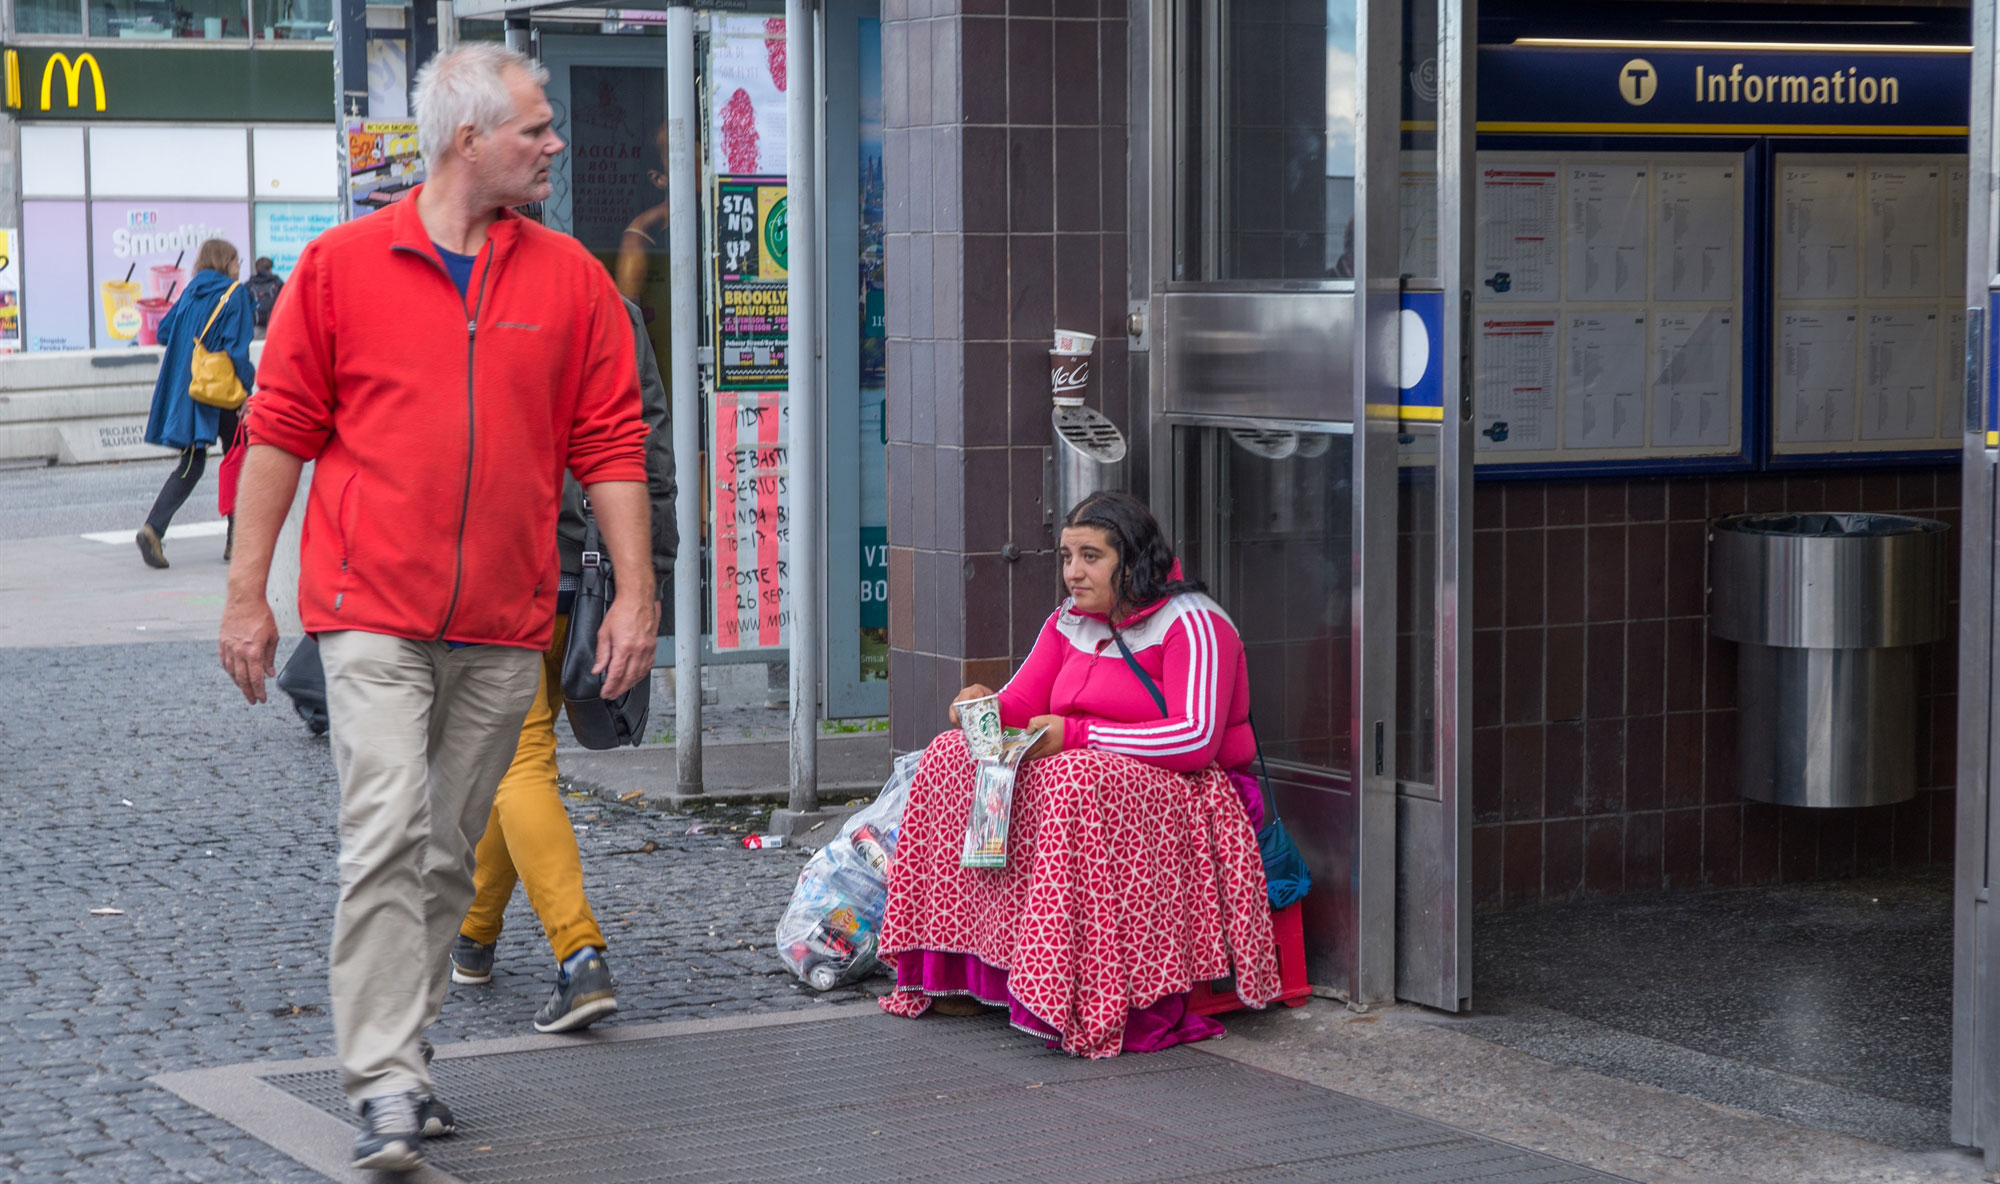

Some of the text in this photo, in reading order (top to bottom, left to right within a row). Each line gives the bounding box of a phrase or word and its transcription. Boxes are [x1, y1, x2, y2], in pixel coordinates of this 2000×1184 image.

[1696, 63, 1899, 105] Information
[722, 194, 754, 215] STA
[131, 211, 157, 225] ICED
[728, 213, 753, 233] ND
[724, 290, 788, 305] BROOKLY
[736, 305, 767, 316] DAVID
[99, 425, 144, 437] PROJEKT
[102, 436, 145, 448] SLUSSEN
[728, 476, 787, 504] SERIUS
[725, 507, 766, 528] LINDA
[726, 565, 771, 589] POSTE
[736, 590, 757, 609] 26
